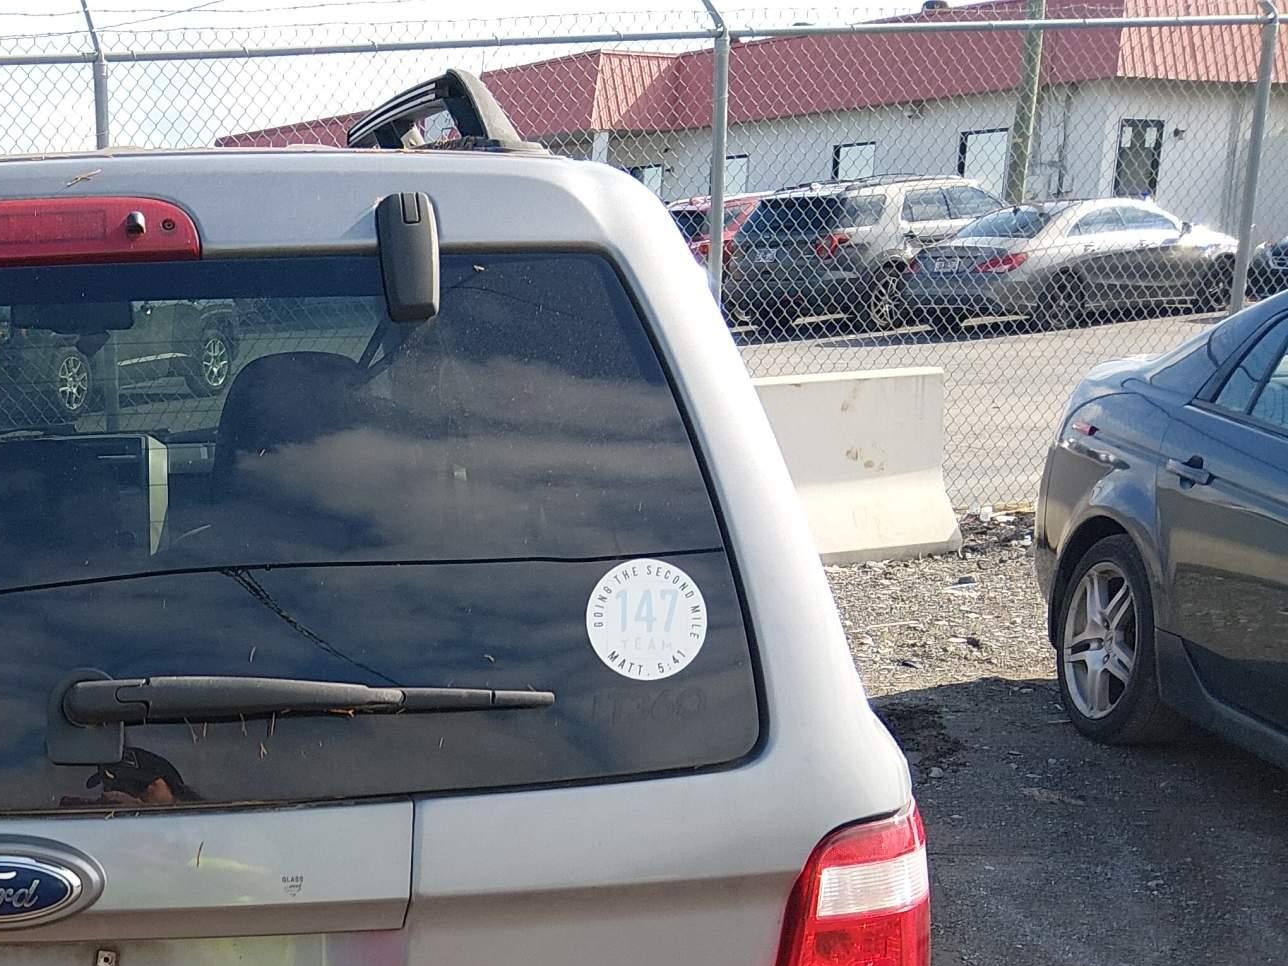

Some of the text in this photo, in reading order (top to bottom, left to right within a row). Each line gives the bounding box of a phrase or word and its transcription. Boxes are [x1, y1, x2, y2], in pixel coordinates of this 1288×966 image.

[593, 565, 702, 639] GOING THE SECOND MILE
[615, 588, 679, 633] 147
[621, 637, 673, 650] TEAM
[608, 650, 686, 676] MATT. 5:41
